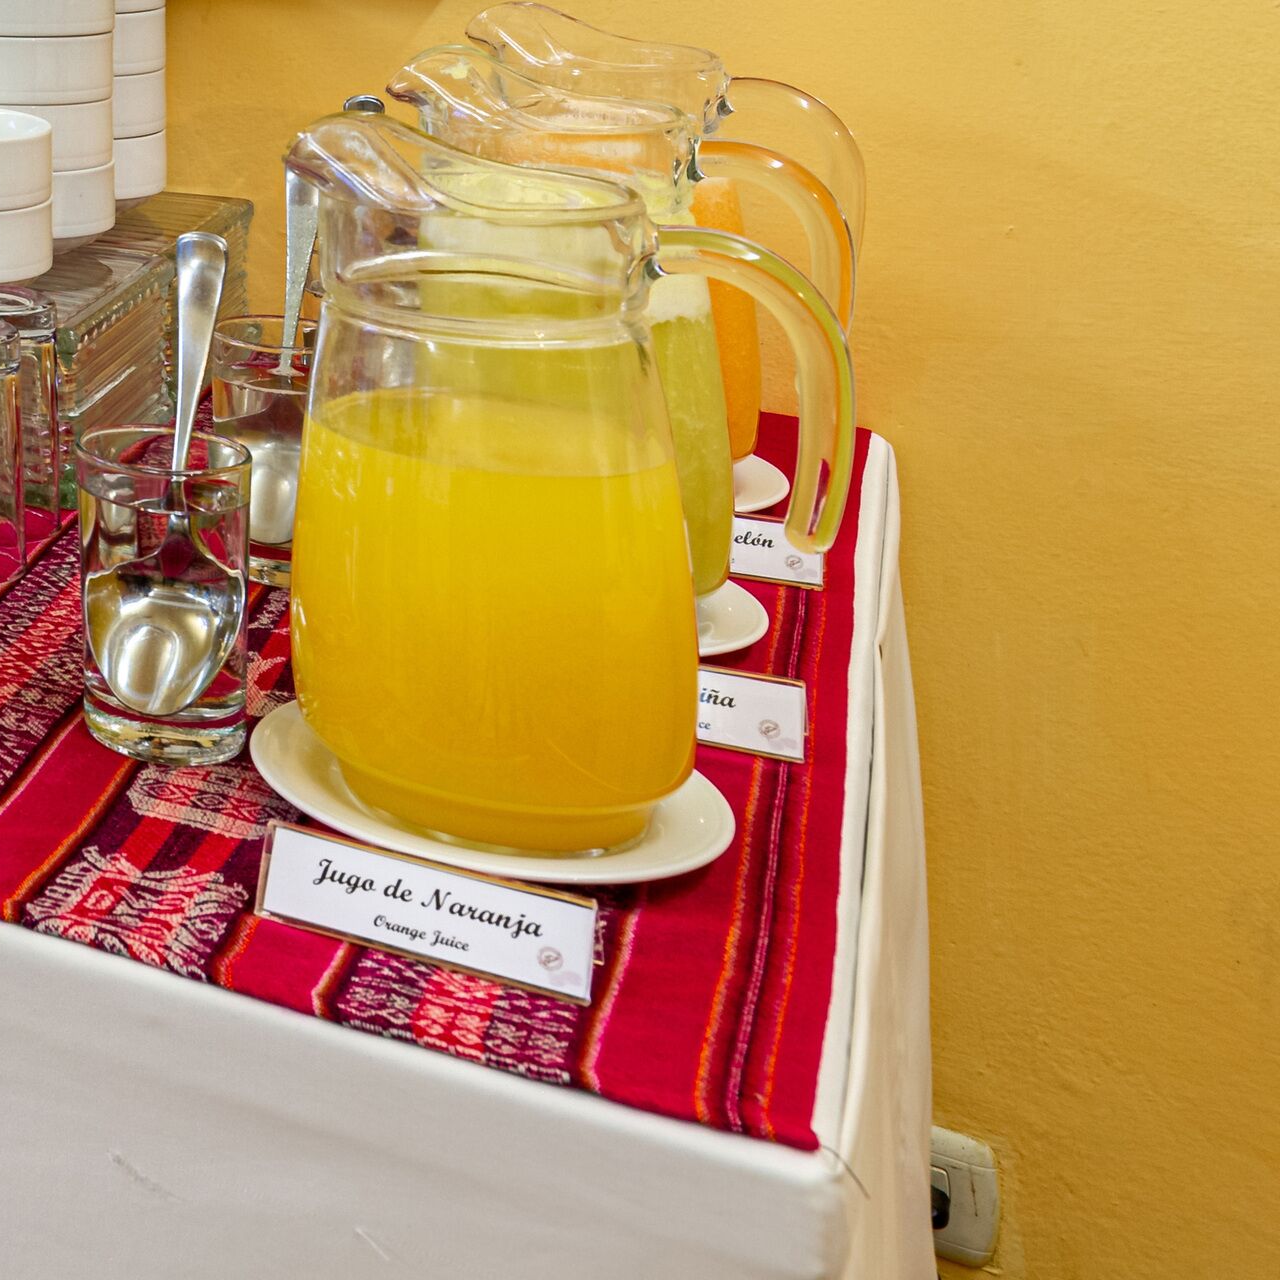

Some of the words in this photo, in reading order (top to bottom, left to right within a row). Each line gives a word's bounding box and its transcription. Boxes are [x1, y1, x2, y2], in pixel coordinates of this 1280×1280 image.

[733, 530, 775, 549] elón
[699, 687, 737, 710] iña
[312, 857, 377, 894] Jugo
[383, 881, 414, 904] de
[421, 887, 545, 941] Naranja
[372, 913, 428, 944] Orange
[429, 927, 471, 954] Juice
